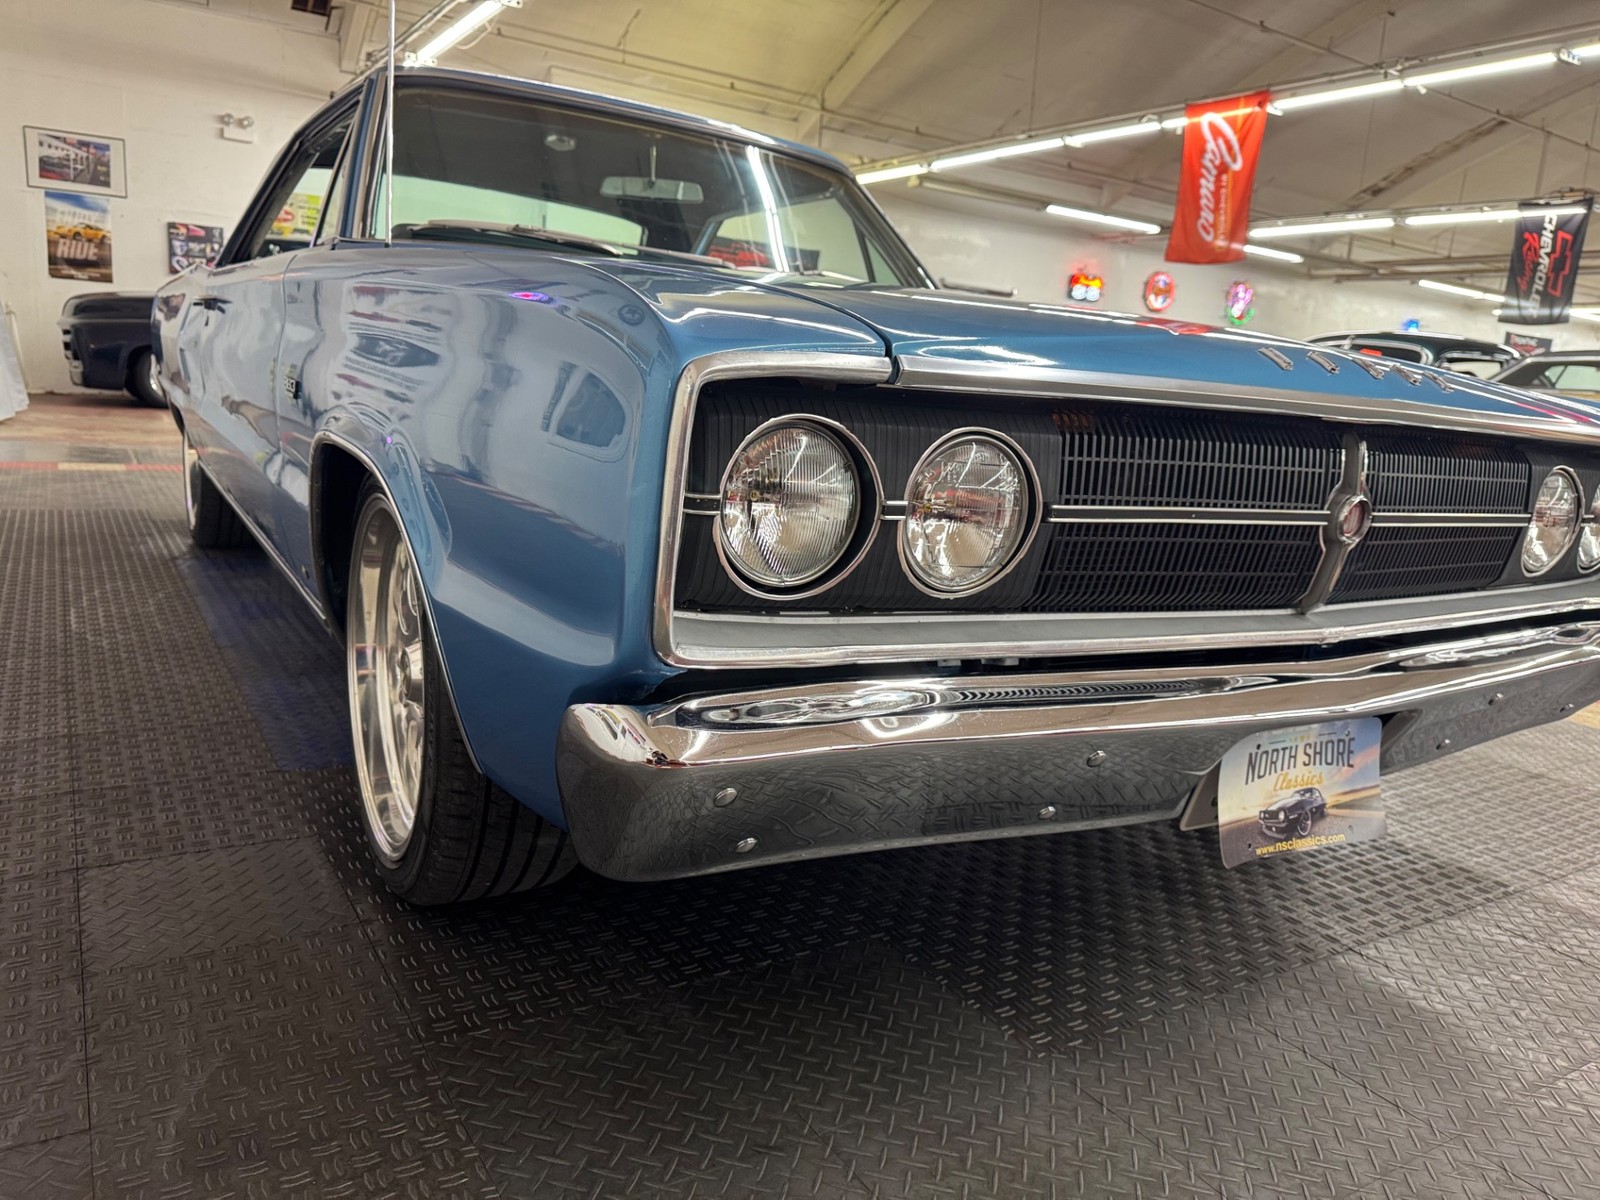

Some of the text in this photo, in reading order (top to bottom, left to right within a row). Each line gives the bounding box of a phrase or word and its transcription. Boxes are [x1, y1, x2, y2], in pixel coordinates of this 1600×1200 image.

[1197, 112, 1242, 241] Camaro
[57, 238, 98, 260] RIDE
[1245, 737, 1356, 785] NORTH SHORE
[1273, 770, 1325, 792] Classics
[1254, 832, 1346, 856] www.nsclassics.com
